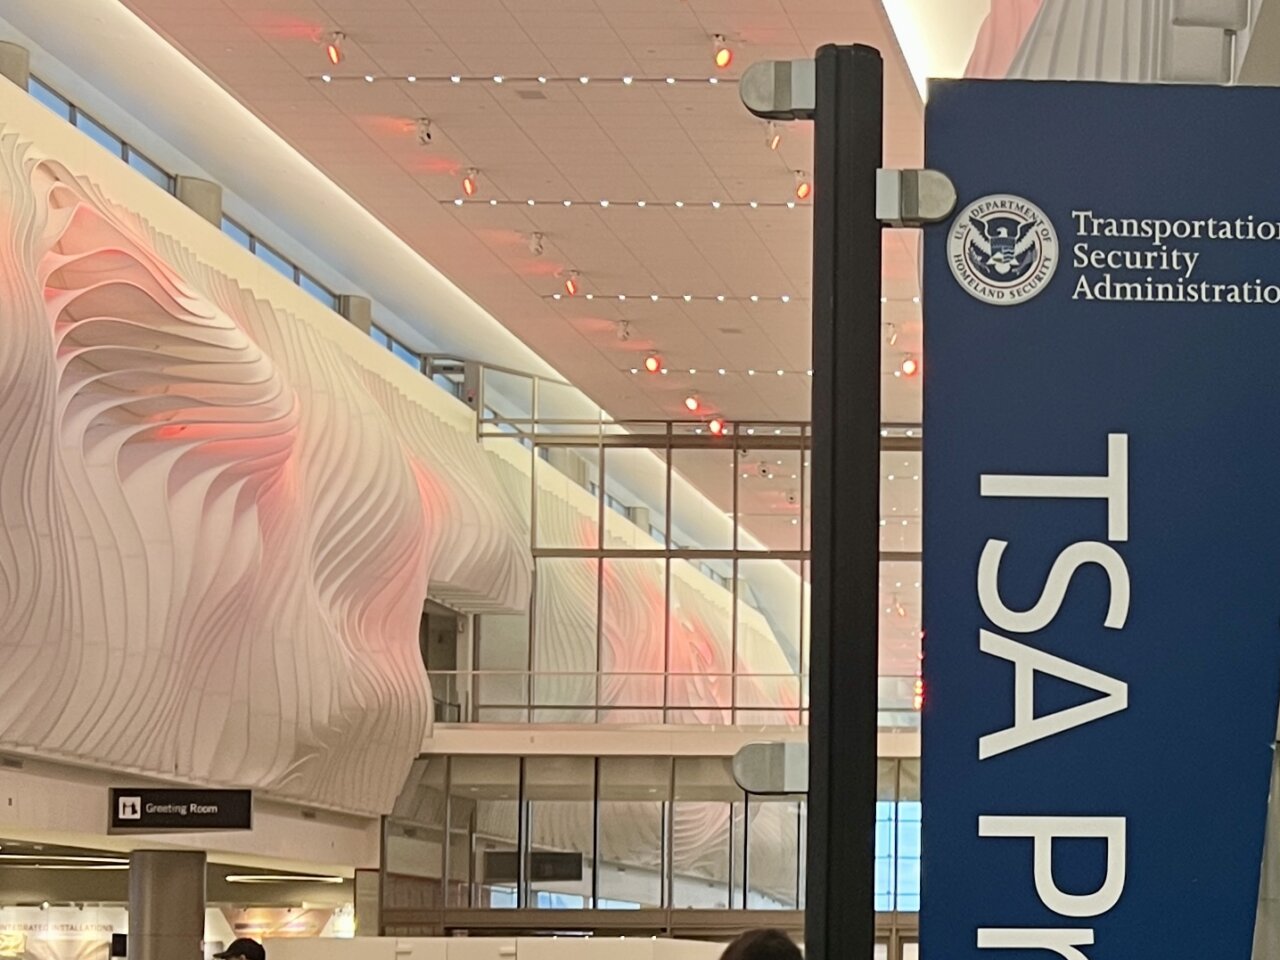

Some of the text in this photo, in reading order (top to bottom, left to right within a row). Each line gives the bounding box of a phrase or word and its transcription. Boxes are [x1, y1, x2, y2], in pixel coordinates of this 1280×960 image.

[970, 200, 1045, 228] DEPARTMENT
[1040, 228, 1053, 242] OF
[953, 254, 1052, 299] HOMELAND SECURITY
[1073, 242, 1199, 278] Security
[977, 432, 1130, 761] TSA
[145, 803, 218, 815] Greeting Room
